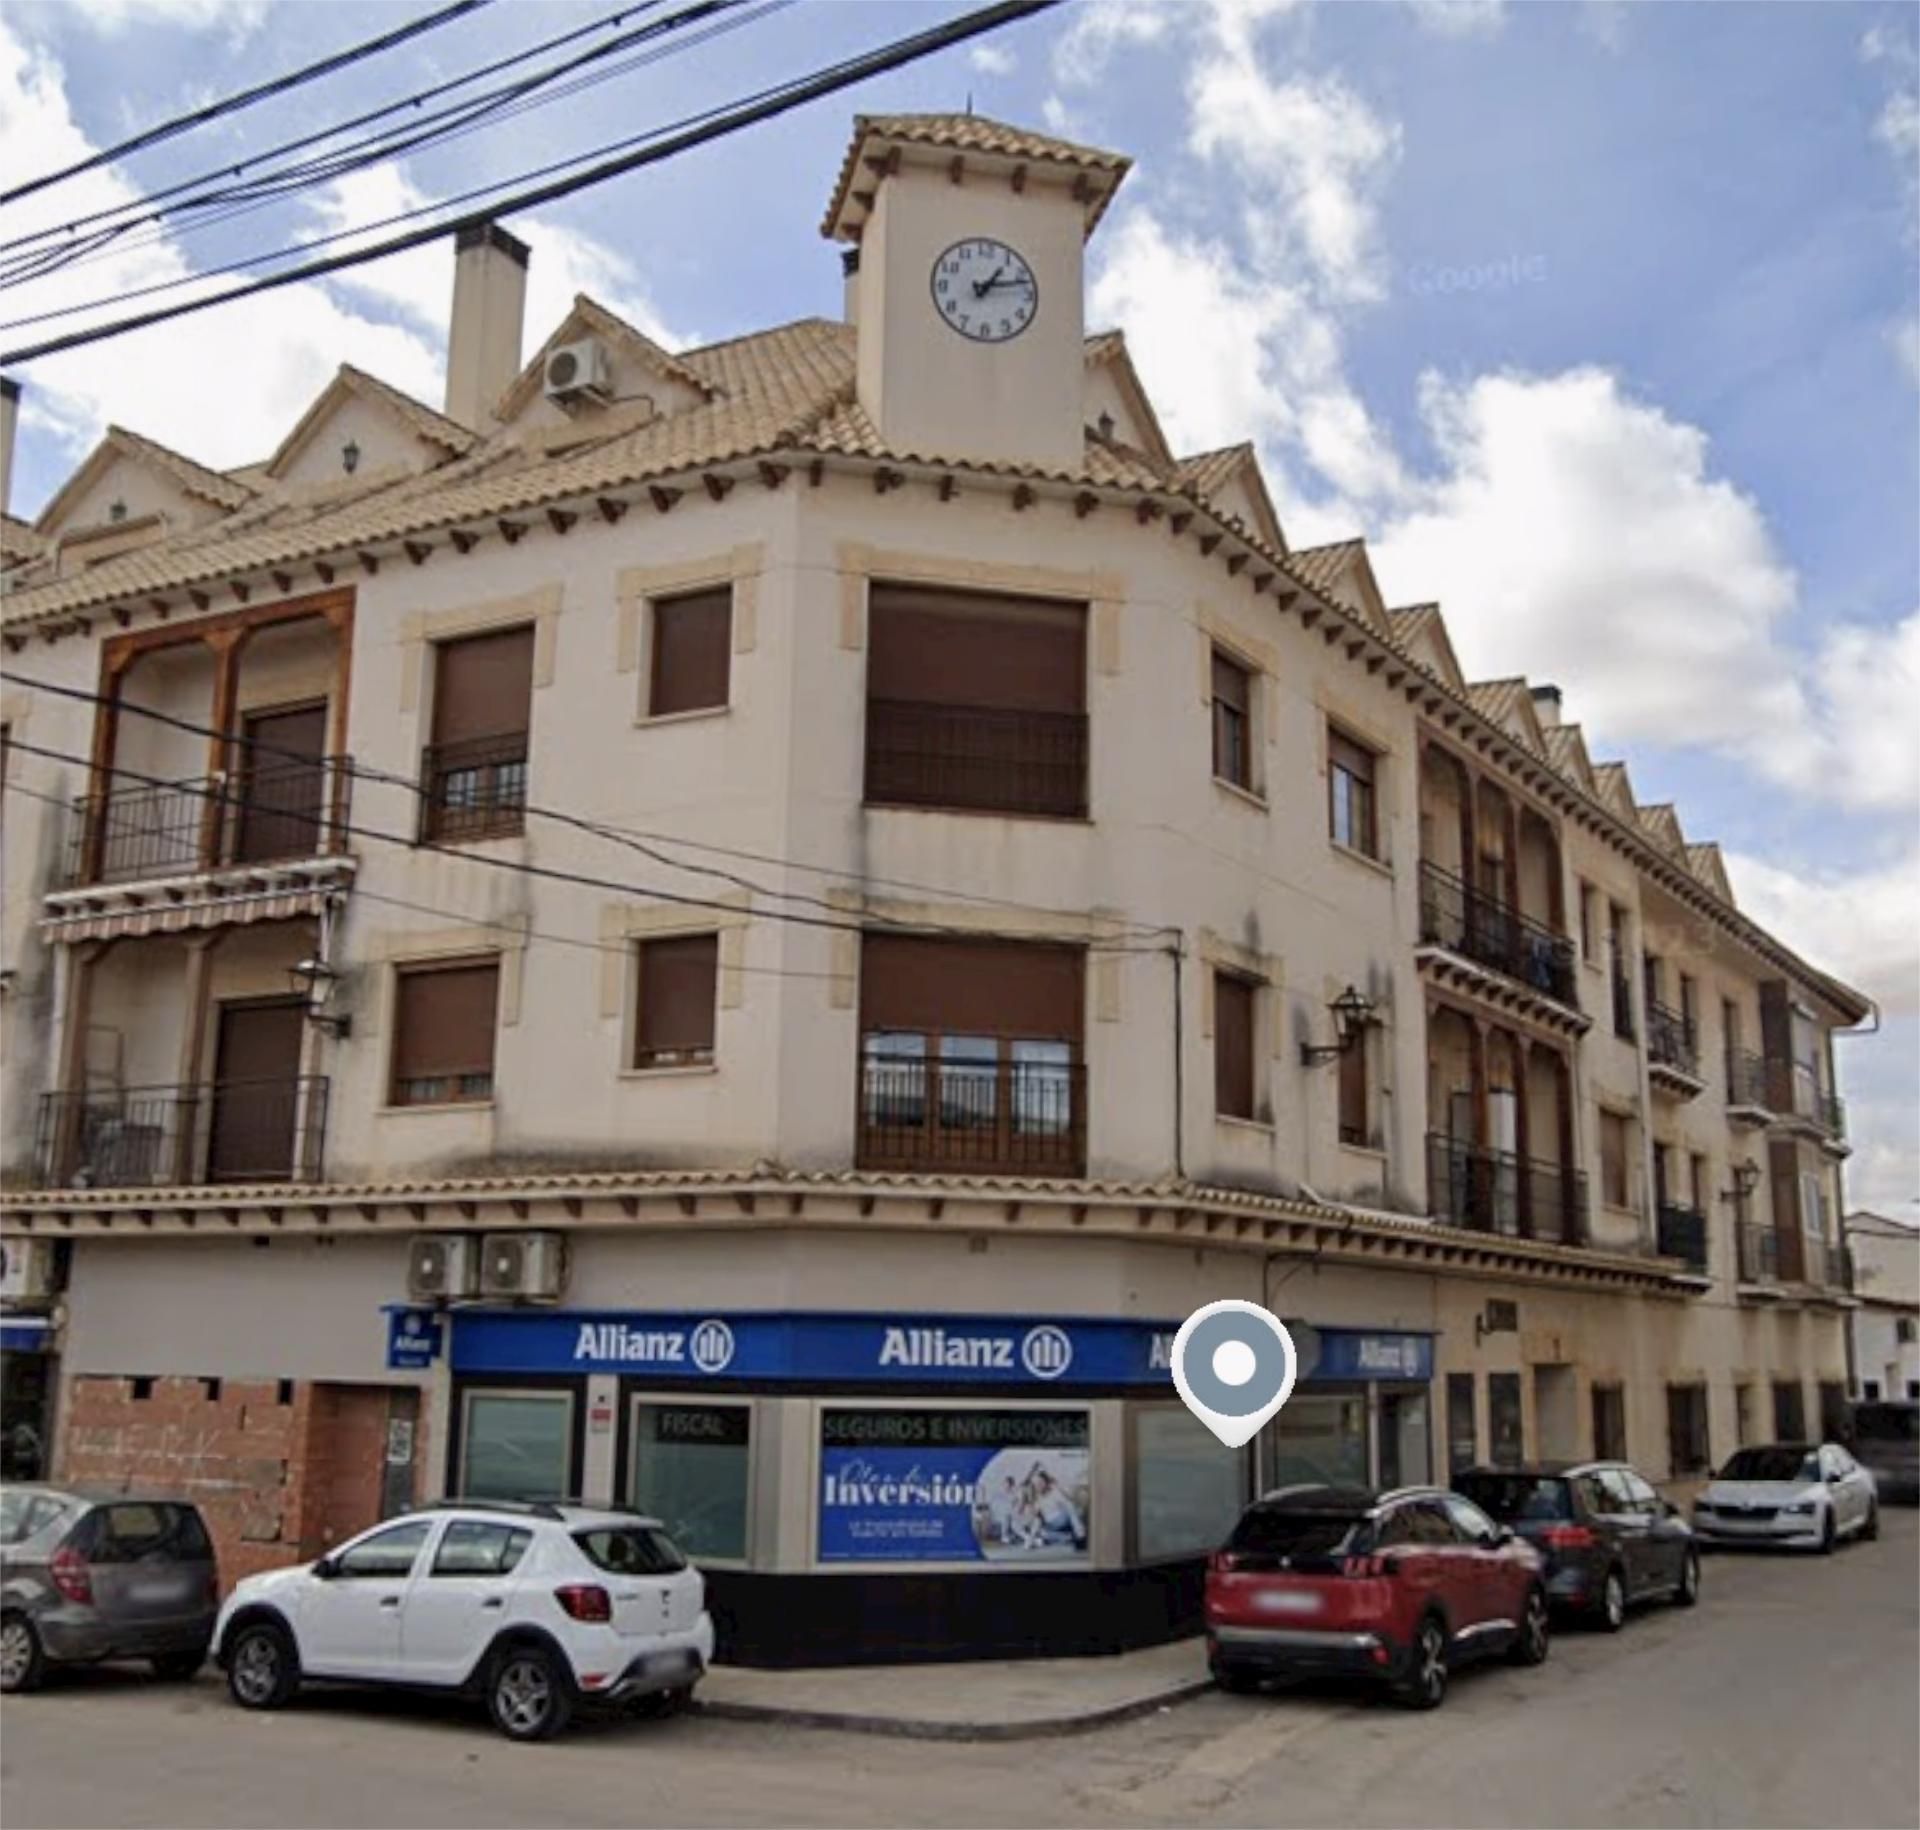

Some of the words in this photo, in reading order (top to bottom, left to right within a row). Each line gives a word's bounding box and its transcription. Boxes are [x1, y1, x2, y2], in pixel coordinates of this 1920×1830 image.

[573, 1322, 685, 1362] Allianz
[878, 1327, 1014, 1367] Allianz
[662, 1412, 725, 1437] FISCAL
[824, 1414, 926, 1440] SEGUROS
[929, 1415, 945, 1440] E
[948, 1415, 1087, 1442] INVERSIONES
[825, 1473, 985, 1506] Inversión
